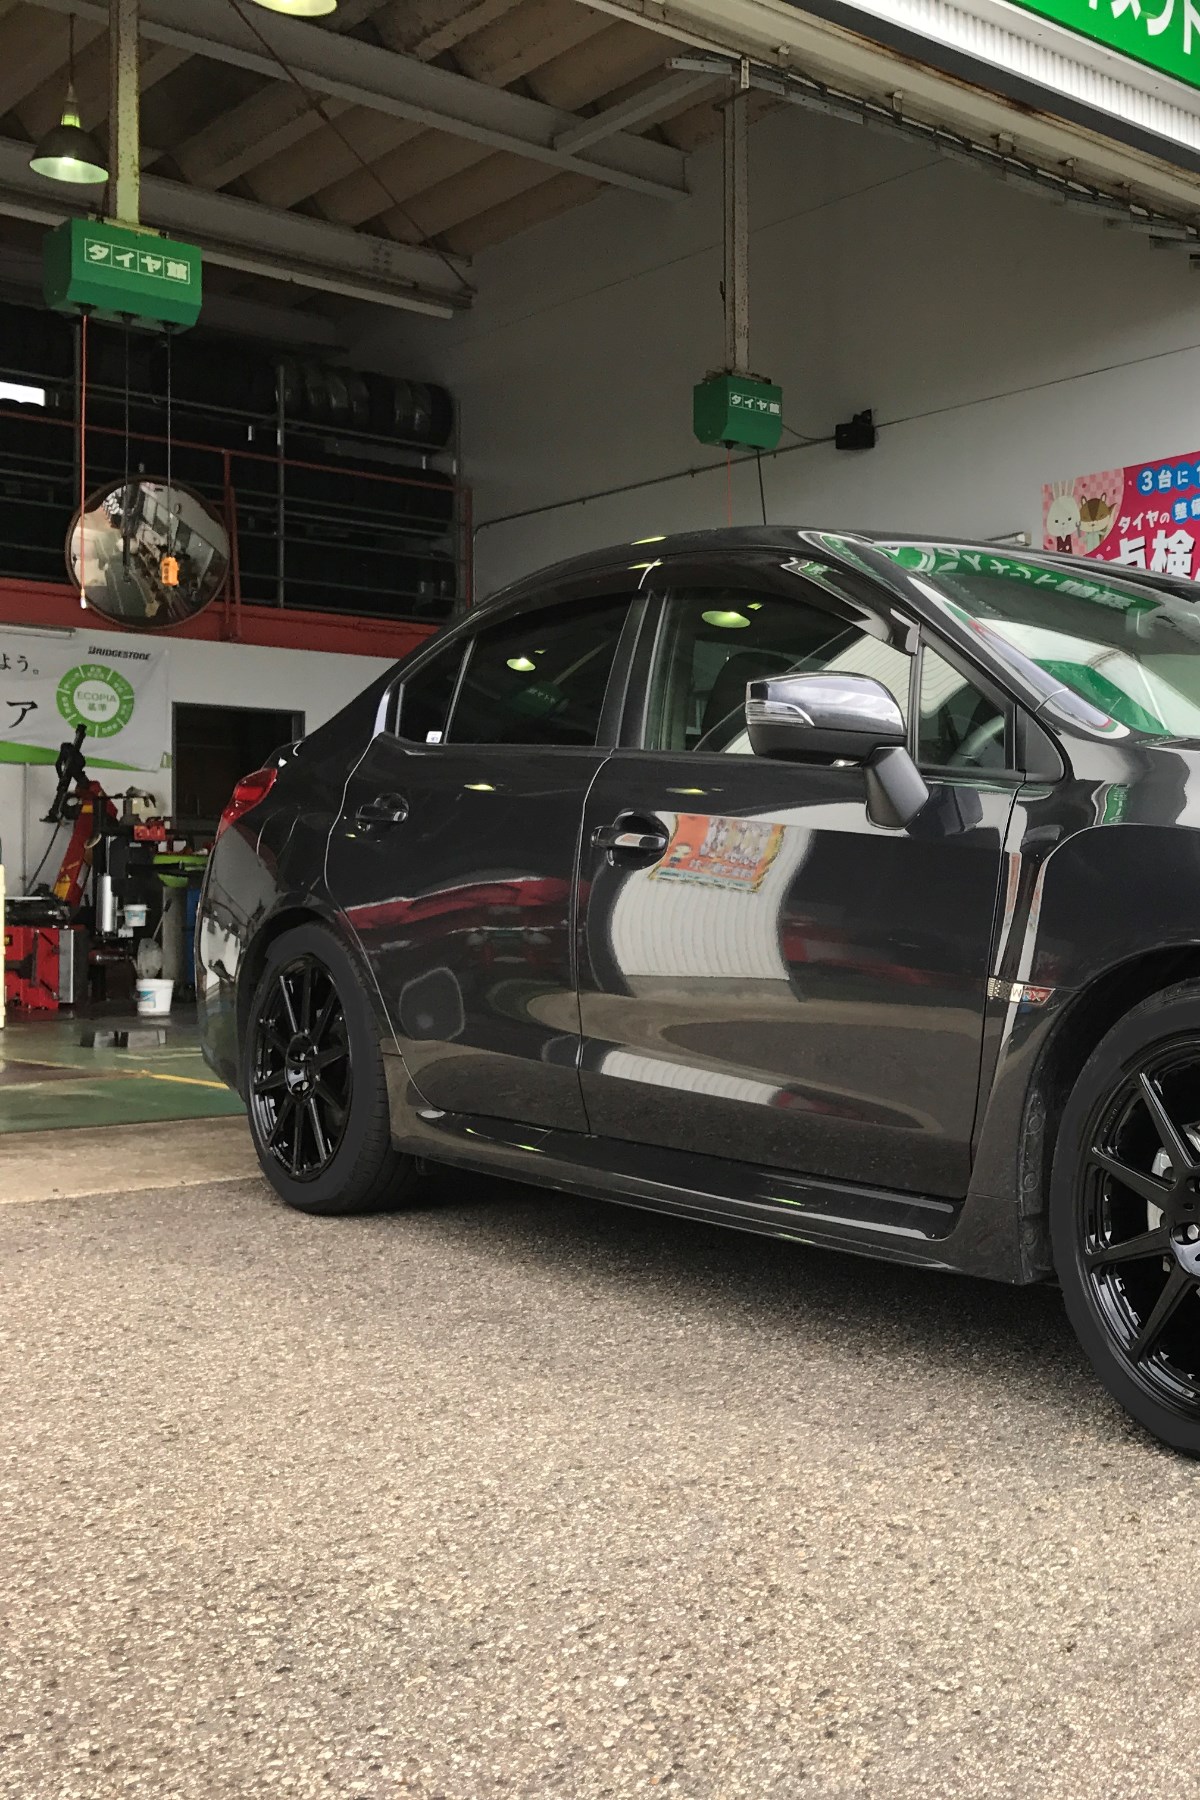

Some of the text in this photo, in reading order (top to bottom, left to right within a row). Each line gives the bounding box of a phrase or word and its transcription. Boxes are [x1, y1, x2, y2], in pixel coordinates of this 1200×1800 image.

[88, 244, 188, 281] タイヤ館
[731, 394, 780, 414] タイヤ館
[77, 691, 117, 704] ECOPIA
[6, 700, 38, 728] ア
